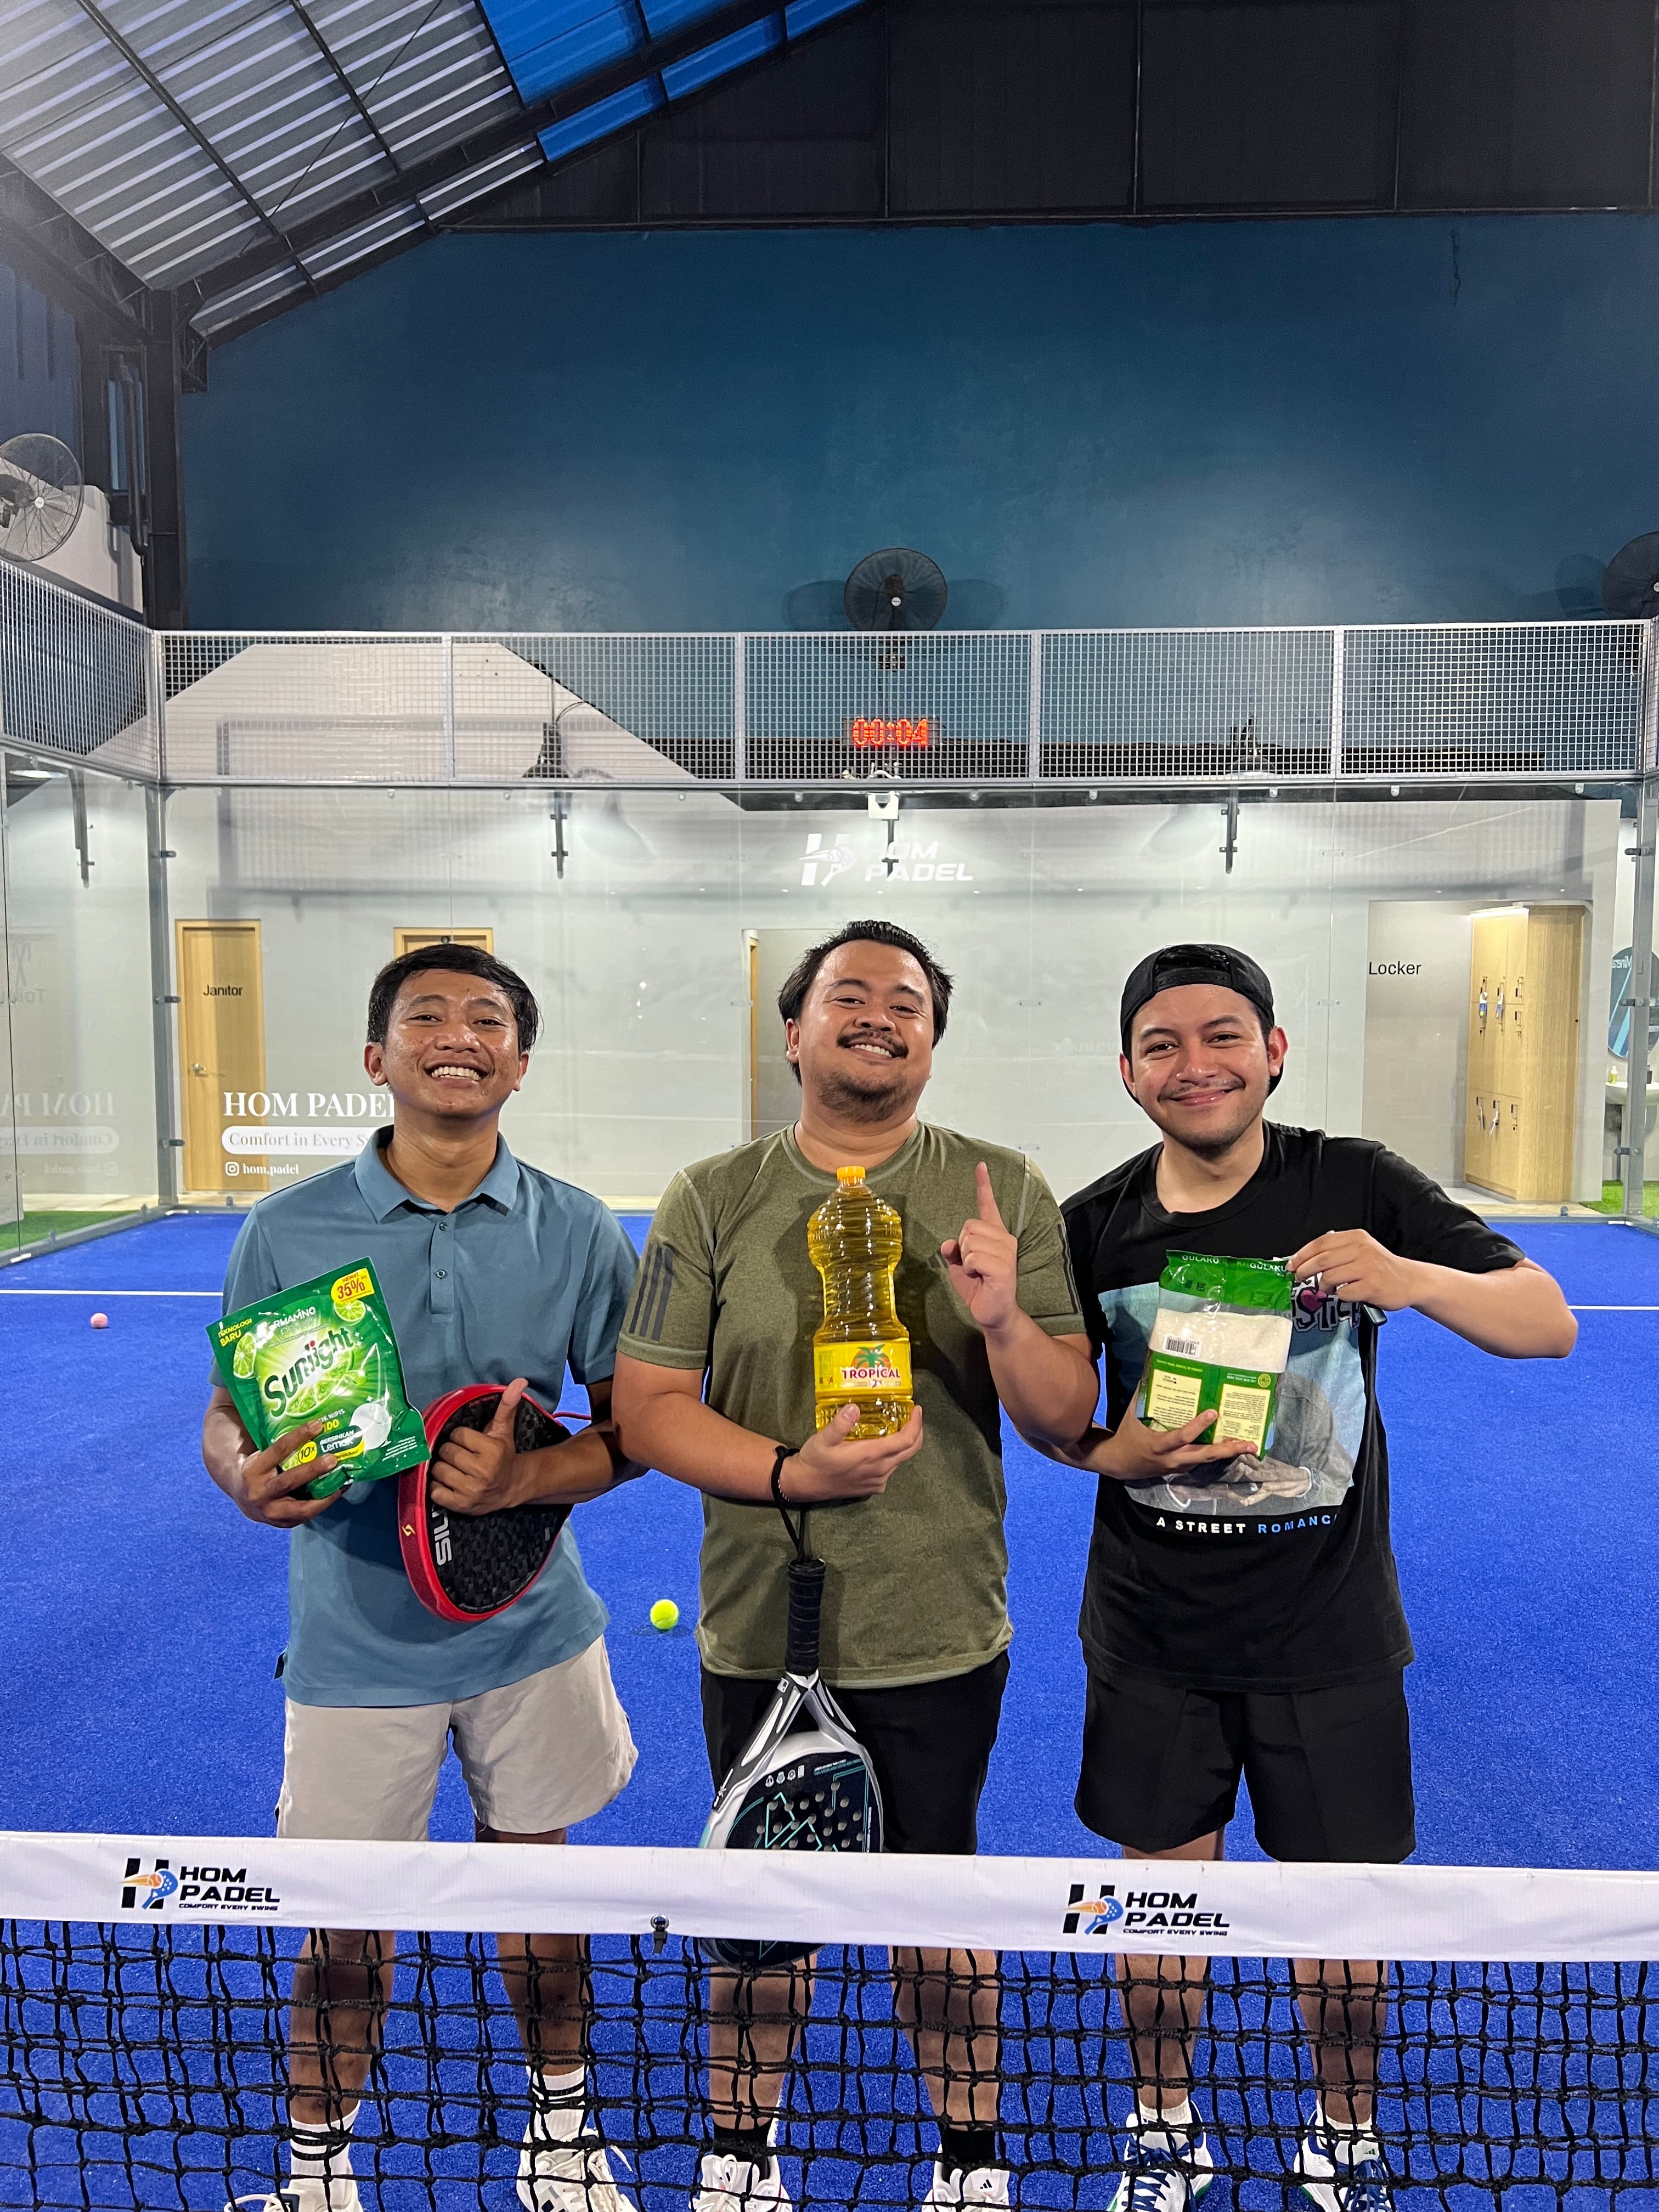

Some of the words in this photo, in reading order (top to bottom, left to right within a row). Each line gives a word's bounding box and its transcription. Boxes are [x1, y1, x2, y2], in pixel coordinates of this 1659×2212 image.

[853, 718, 928, 747] 00:04
[864, 862, 974, 882] PADEL
[1369, 961, 1422, 975] Locker
[203, 984, 243, 996] Janitor
[223, 1091, 298, 1117] HOM
[229, 1132, 289, 1147] Comfort
[295, 1132, 308, 1147] in
[313, 1133, 352, 1150] Every
[242, 1163, 300, 1176] hom.padel
[1182, 1255, 1220, 1265] GULAKU
[1250, 1261, 1287, 1272] GULAKU
[337, 1278, 365, 1300] 35%
[217, 1317, 252, 1339] TEKNOLOGI
[219, 1329, 242, 1347] BARU
[264, 1327, 354, 1418] Sunlight
[842, 1368, 900, 1379] TROPICAL
[328, 1408, 346, 1419] NIPIS
[319, 1429, 355, 1446] BERSIHKAN
[320, 1436, 355, 1453] Lemak
[1156, 1516, 1166, 1527] A
[1175, 1520, 1246, 1534] STREET
[1258, 1514, 1338, 1534] ROMANC
[179, 1866, 247, 1883] HOM
[179, 1884, 280, 1903] PADEL
[1125, 1892, 1198, 1909] HOM
[1125, 1912, 1230, 1928] PADEL
